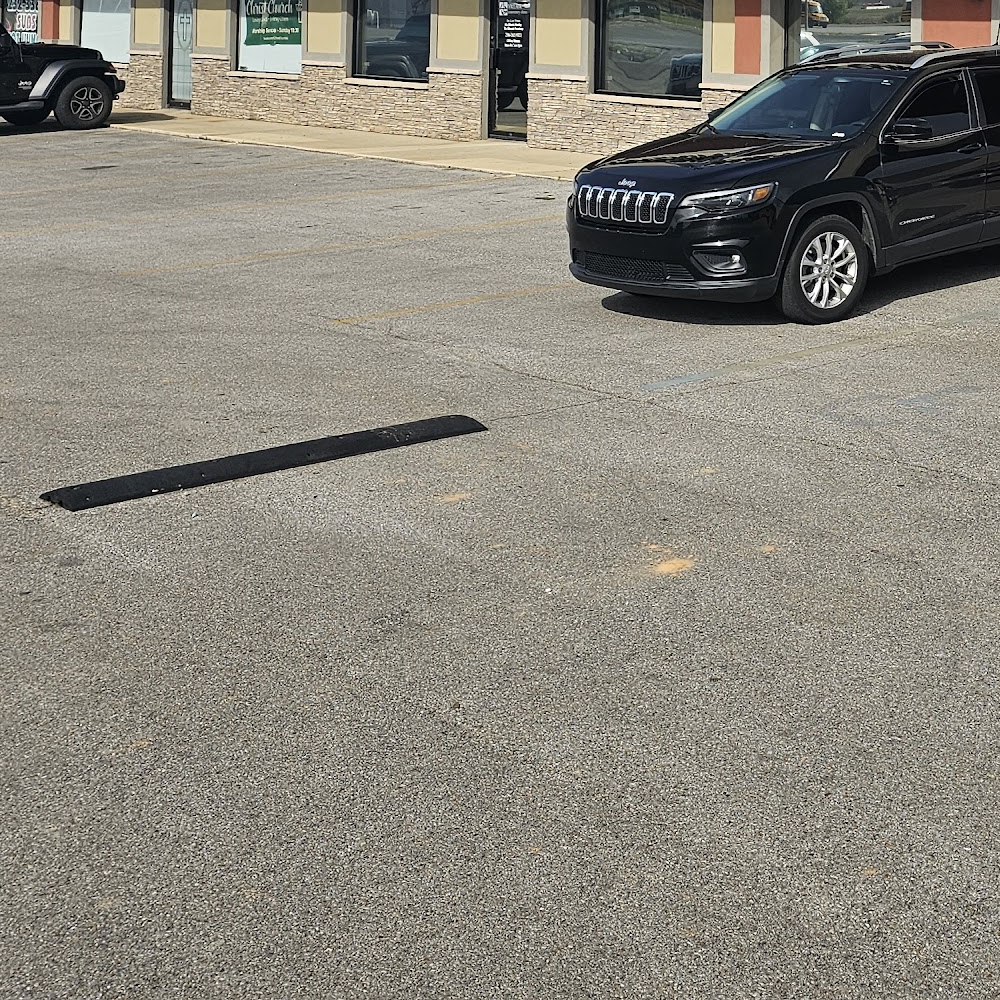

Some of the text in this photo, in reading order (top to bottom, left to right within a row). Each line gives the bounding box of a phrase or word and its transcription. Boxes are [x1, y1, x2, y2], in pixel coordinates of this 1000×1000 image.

[247, 0, 268, 16] Christ
[16, 13, 37, 31] SUBS
[617, 178, 637, 188] Jeep
